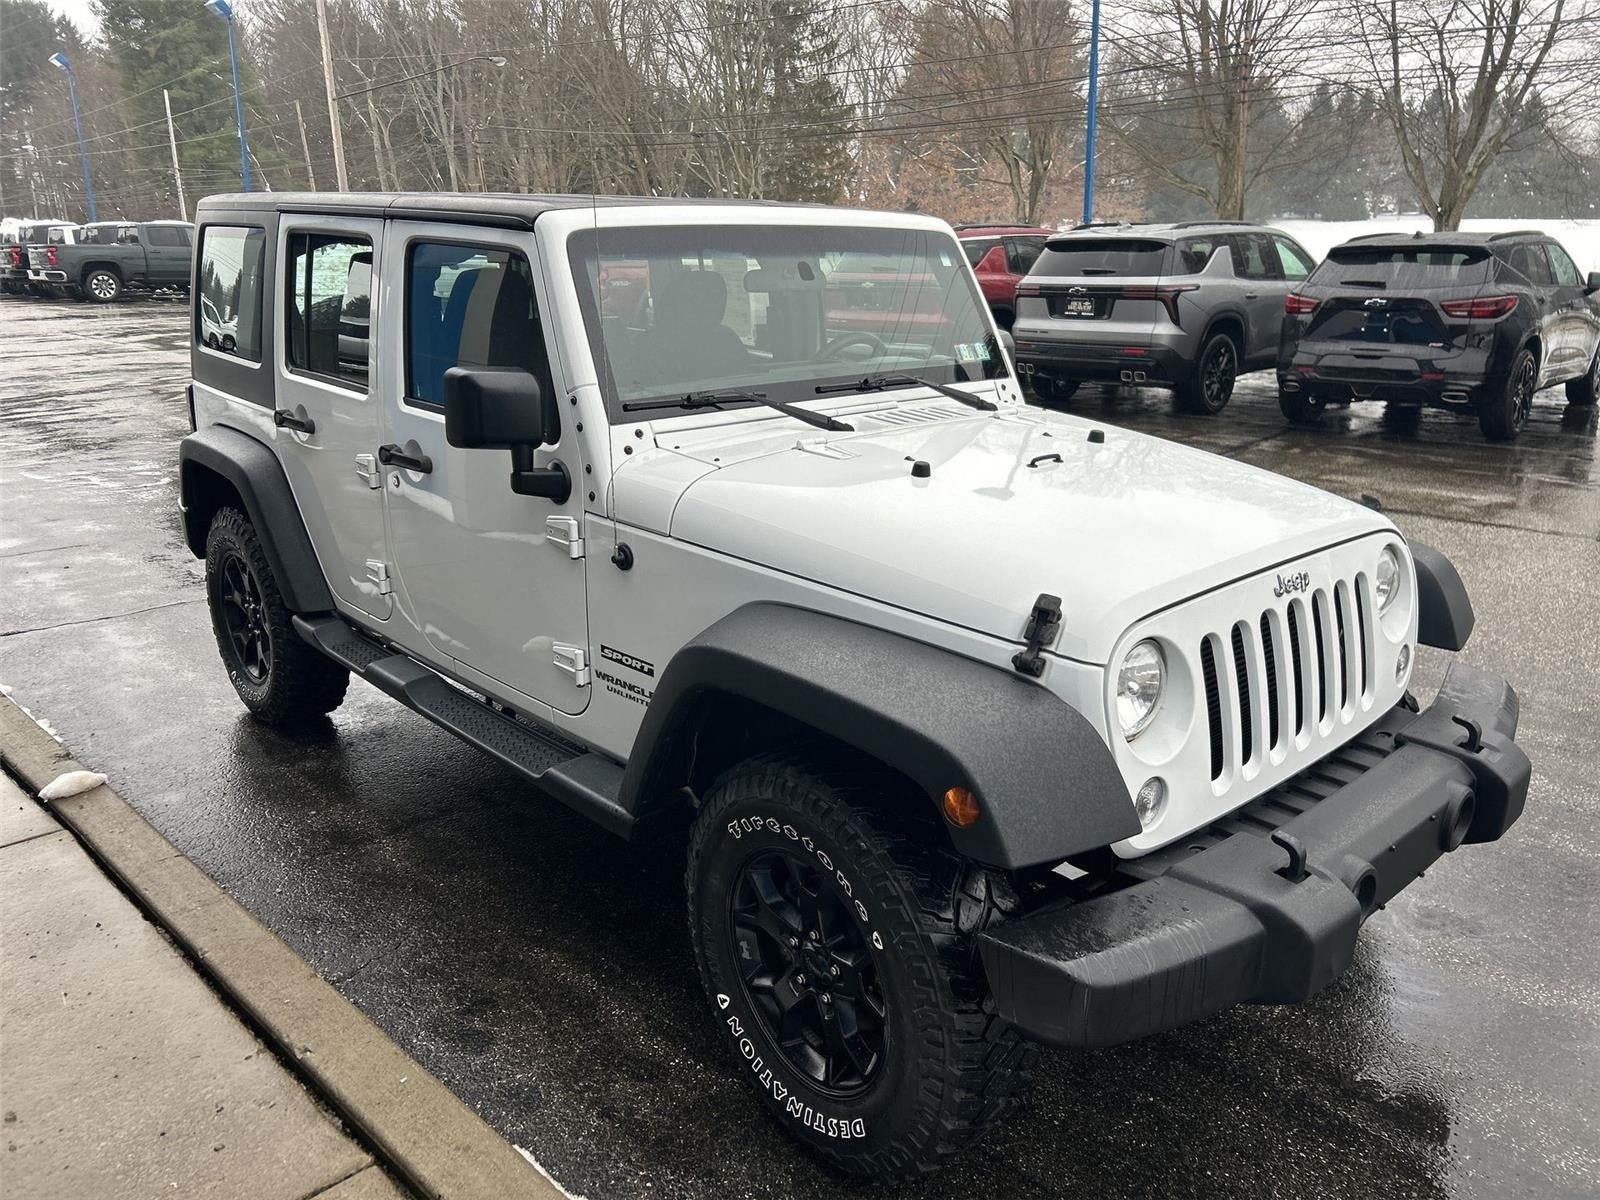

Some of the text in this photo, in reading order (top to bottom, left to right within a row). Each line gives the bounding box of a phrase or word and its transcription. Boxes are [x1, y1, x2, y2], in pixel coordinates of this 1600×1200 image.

[1273, 572, 1310, 598] Jeep
[601, 646, 655, 674] SPORT
[727, 815, 869, 922] Firestone
[726, 1015, 866, 1139] DESTINATION
